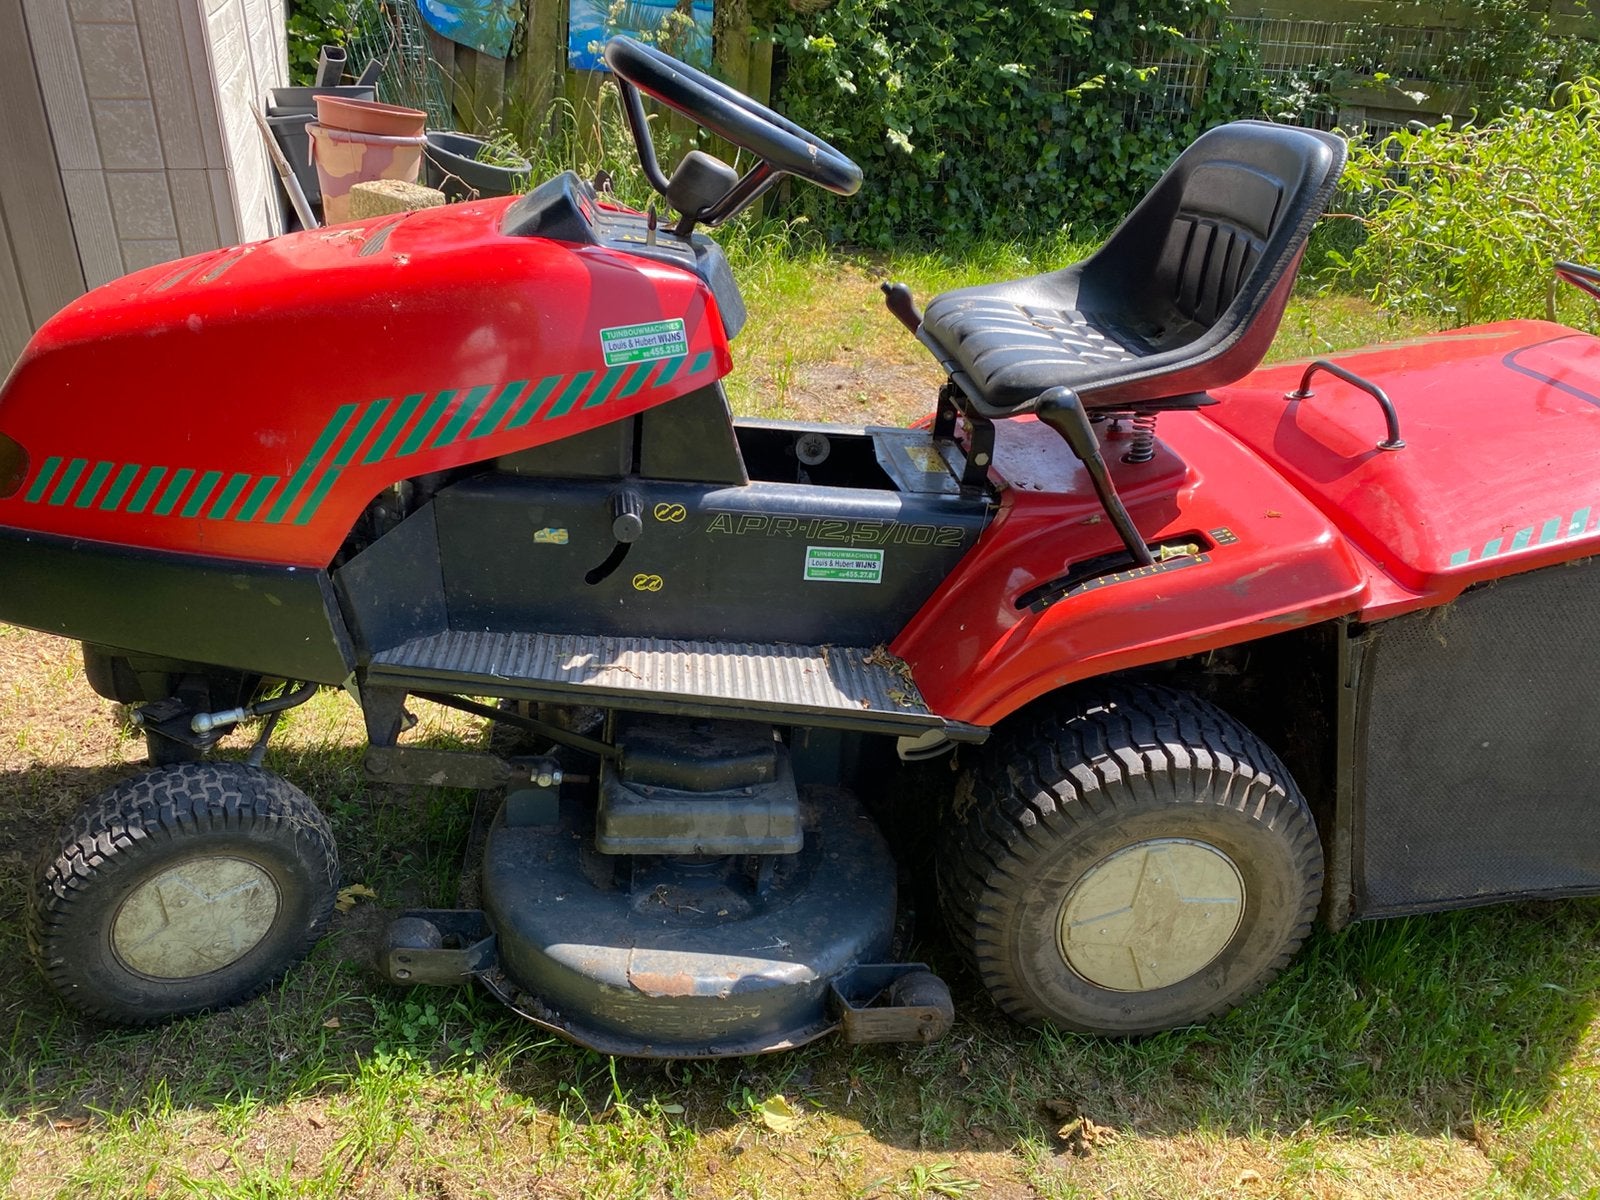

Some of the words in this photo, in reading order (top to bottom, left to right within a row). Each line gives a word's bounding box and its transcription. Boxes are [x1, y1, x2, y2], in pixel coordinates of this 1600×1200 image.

[607, 322, 680, 339] TUINBOUWMACHINES
[608, 341, 627, 351] Louis
[628, 339, 634, 348] &
[635, 337, 657, 347] Hubert
[657, 332, 682, 344] WIJNS
[813, 550, 878, 560] TUINBOUWMACHINES
[835, 560, 854, 568] Hubert
[855, 561, 877, 569] WIJNS
